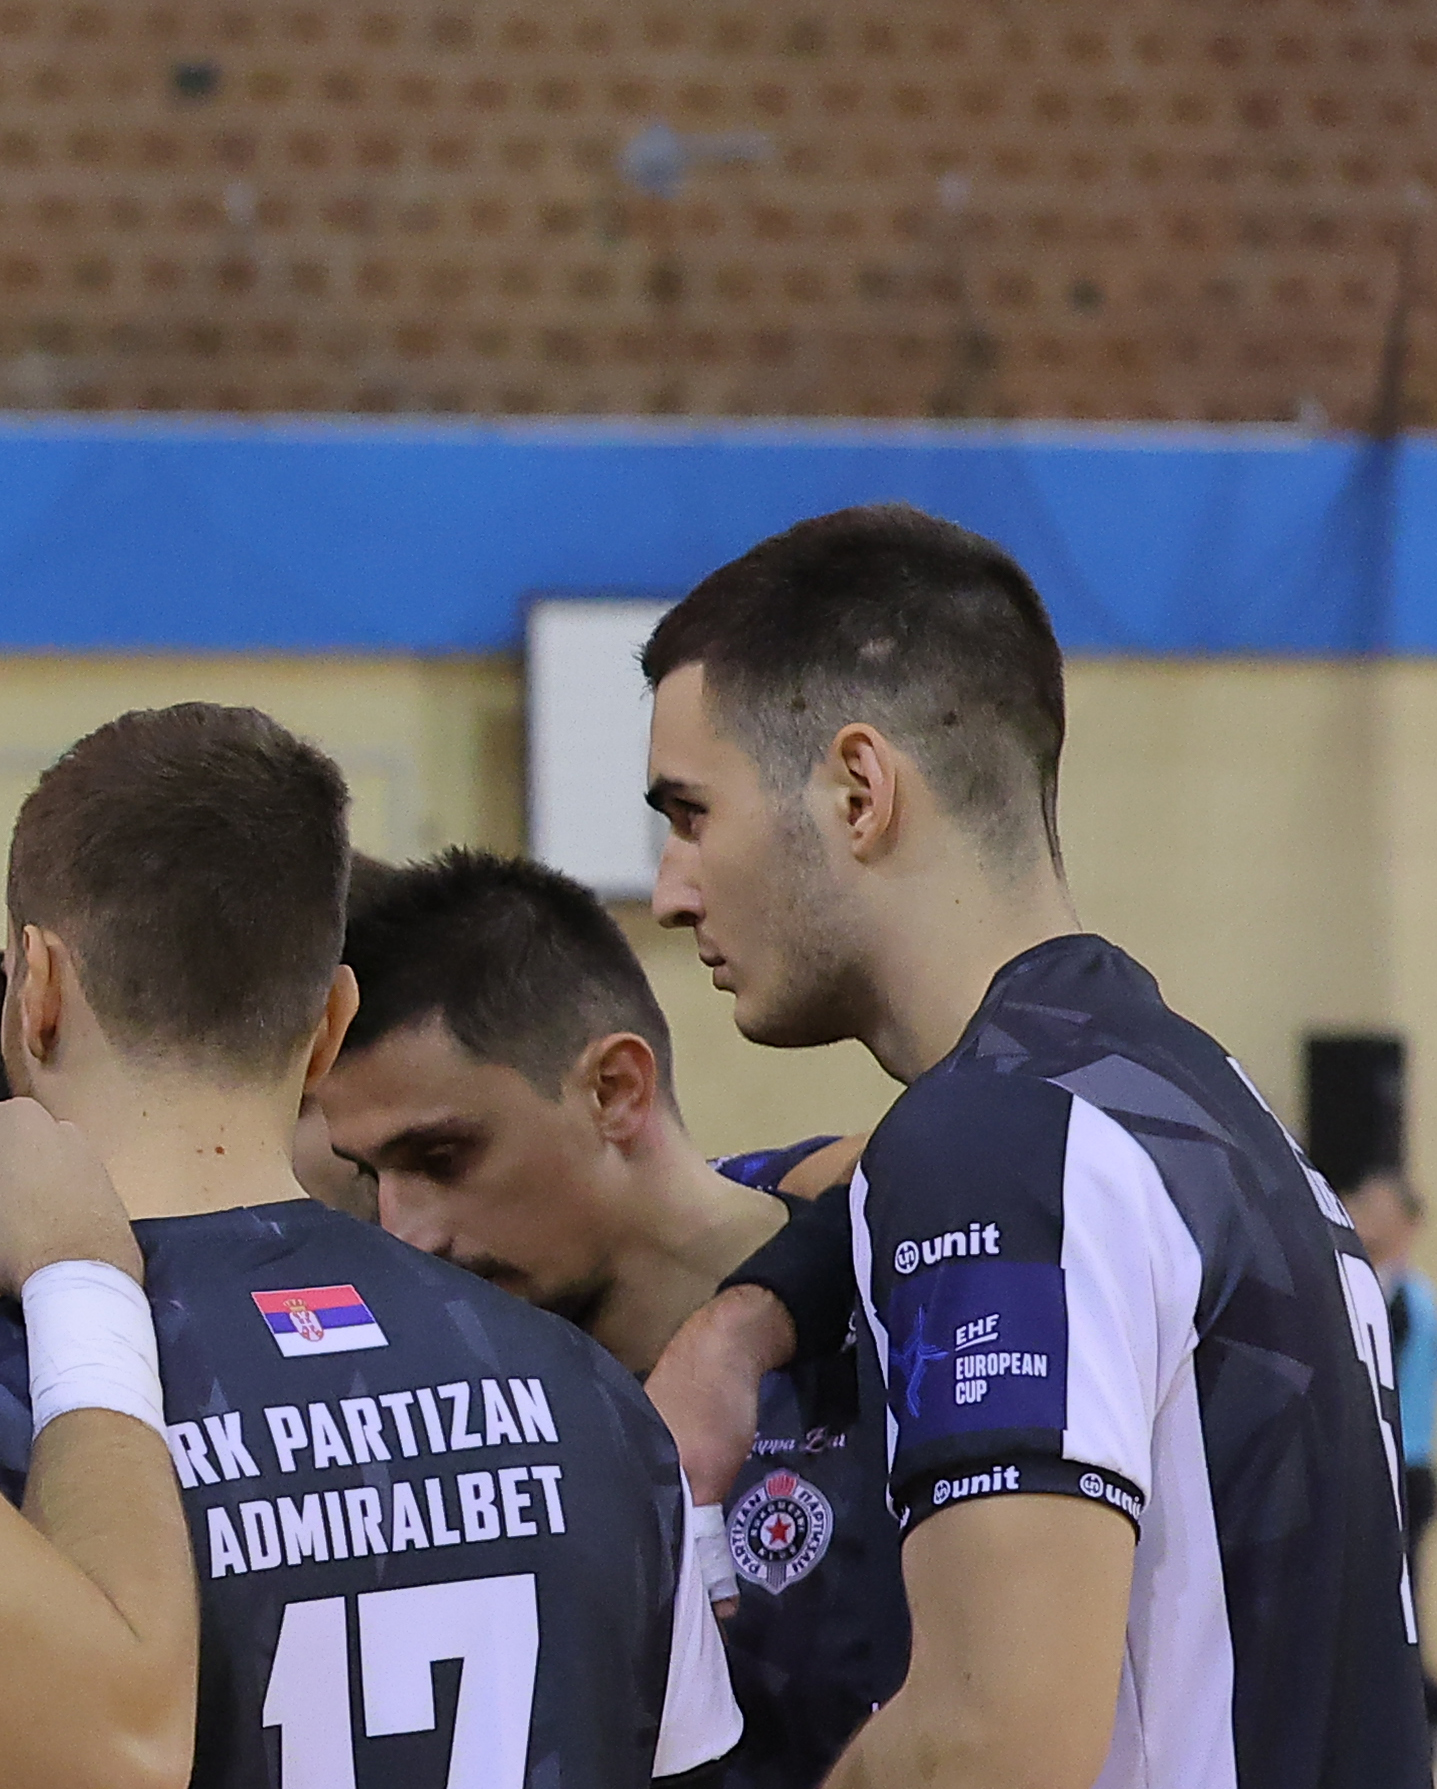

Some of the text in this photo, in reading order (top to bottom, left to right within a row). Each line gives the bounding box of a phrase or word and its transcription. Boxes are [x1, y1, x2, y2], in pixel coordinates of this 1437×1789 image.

[921, 1222, 1000, 1265] unit
[955, 1314, 999, 1346] EHF
[956, 1353, 1047, 1380] EUROPEAN
[956, 1379, 987, 1405] CUP
[166, 1378, 559, 1489] RK PARTIZAN
[951, 1466, 1020, 1499] unit
[207, 1465, 566, 1578] ADMIRALBET
